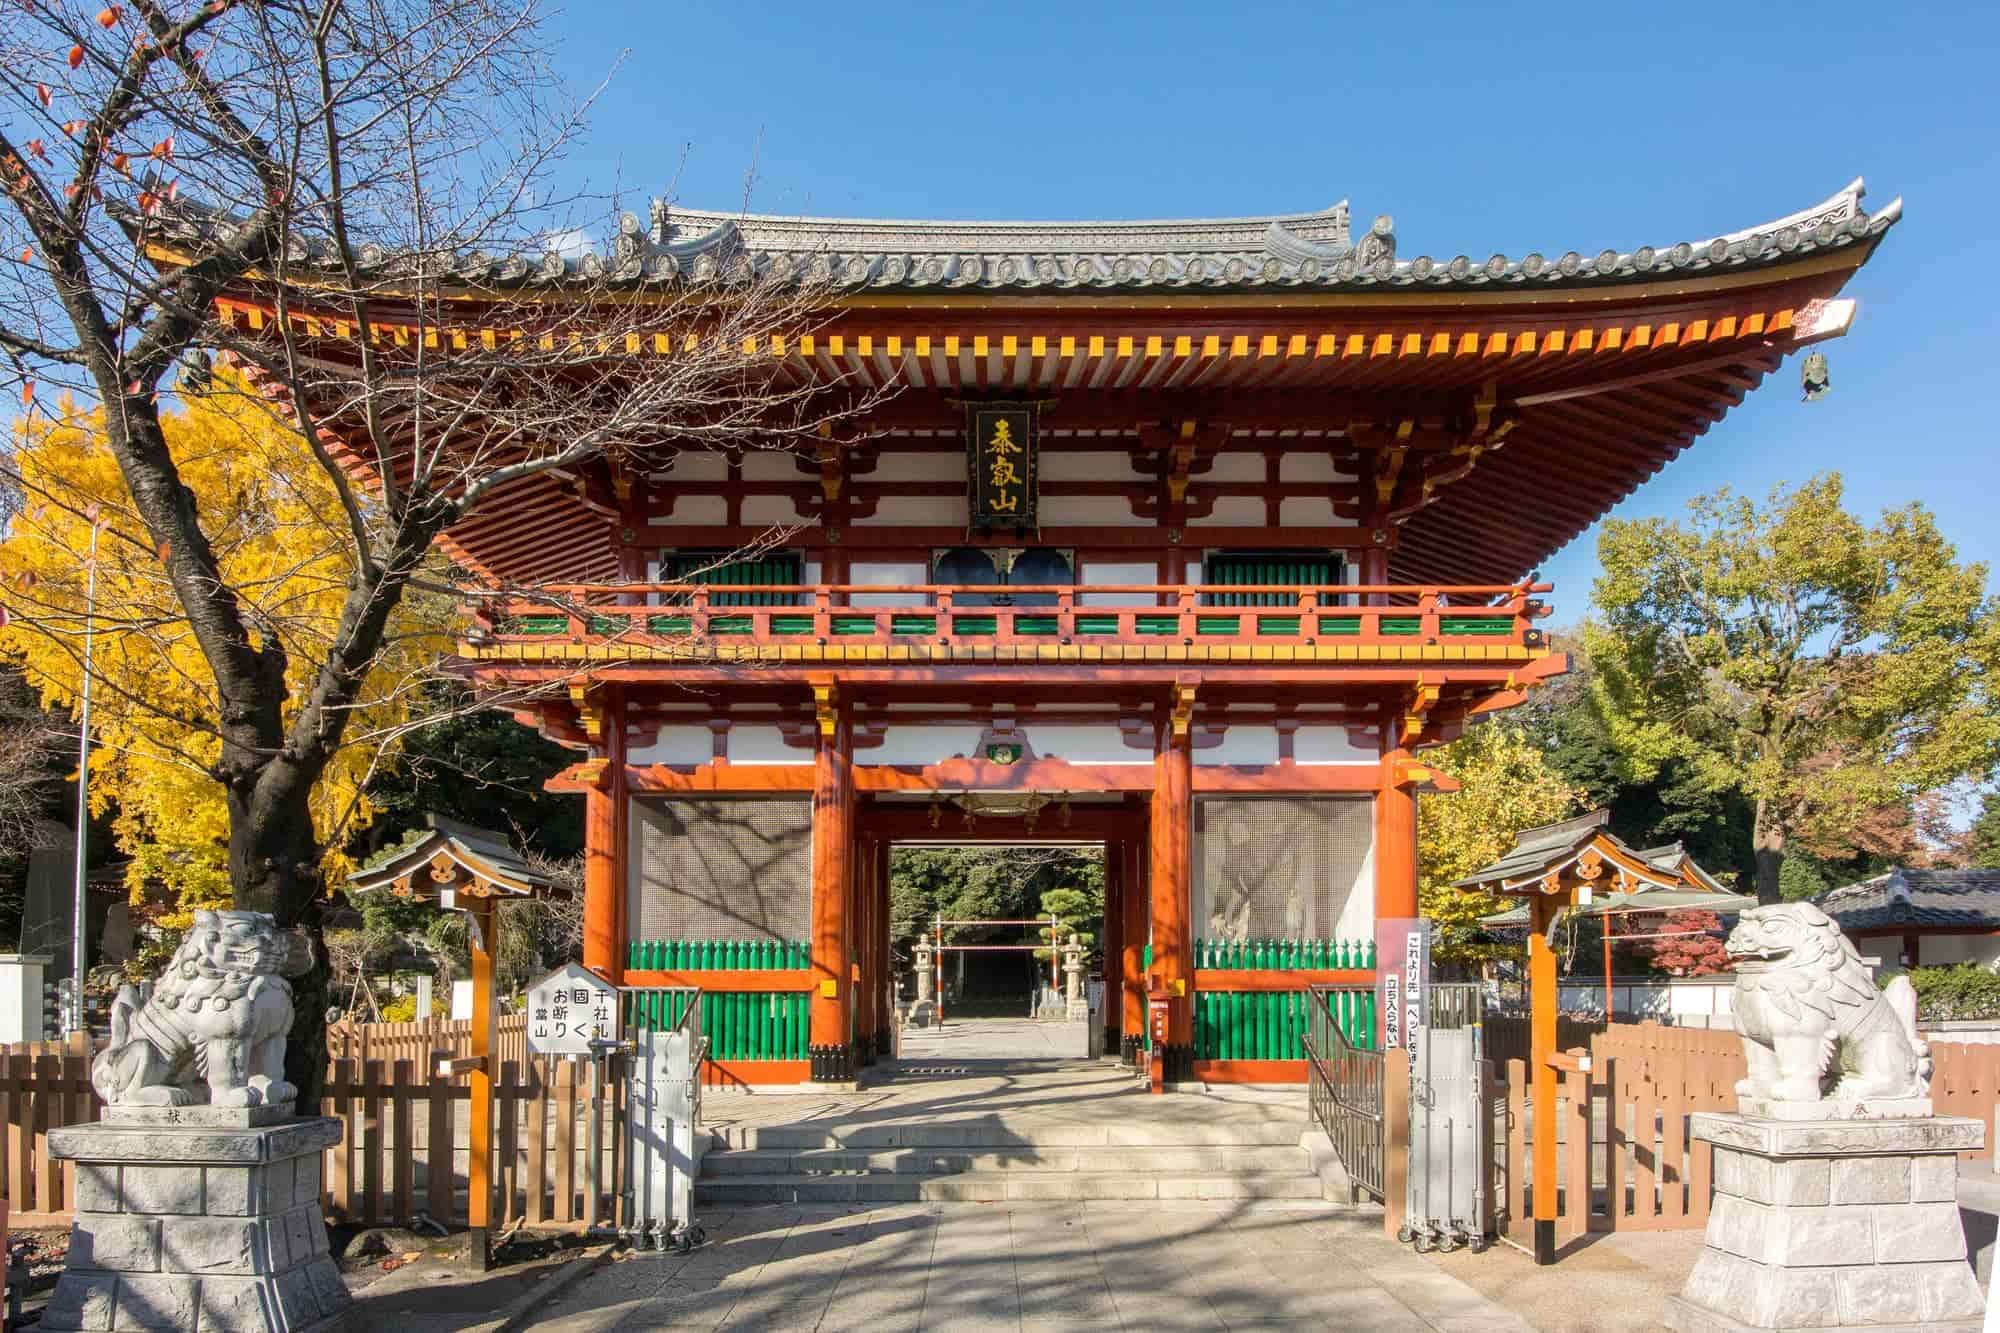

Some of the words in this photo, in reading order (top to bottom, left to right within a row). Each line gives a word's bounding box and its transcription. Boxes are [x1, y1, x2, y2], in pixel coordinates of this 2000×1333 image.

[553, 990, 568, 1038] お断り
[574, 989, 589, 1038] 固く
[1386, 978, 1399, 1049] 立ち入らない
